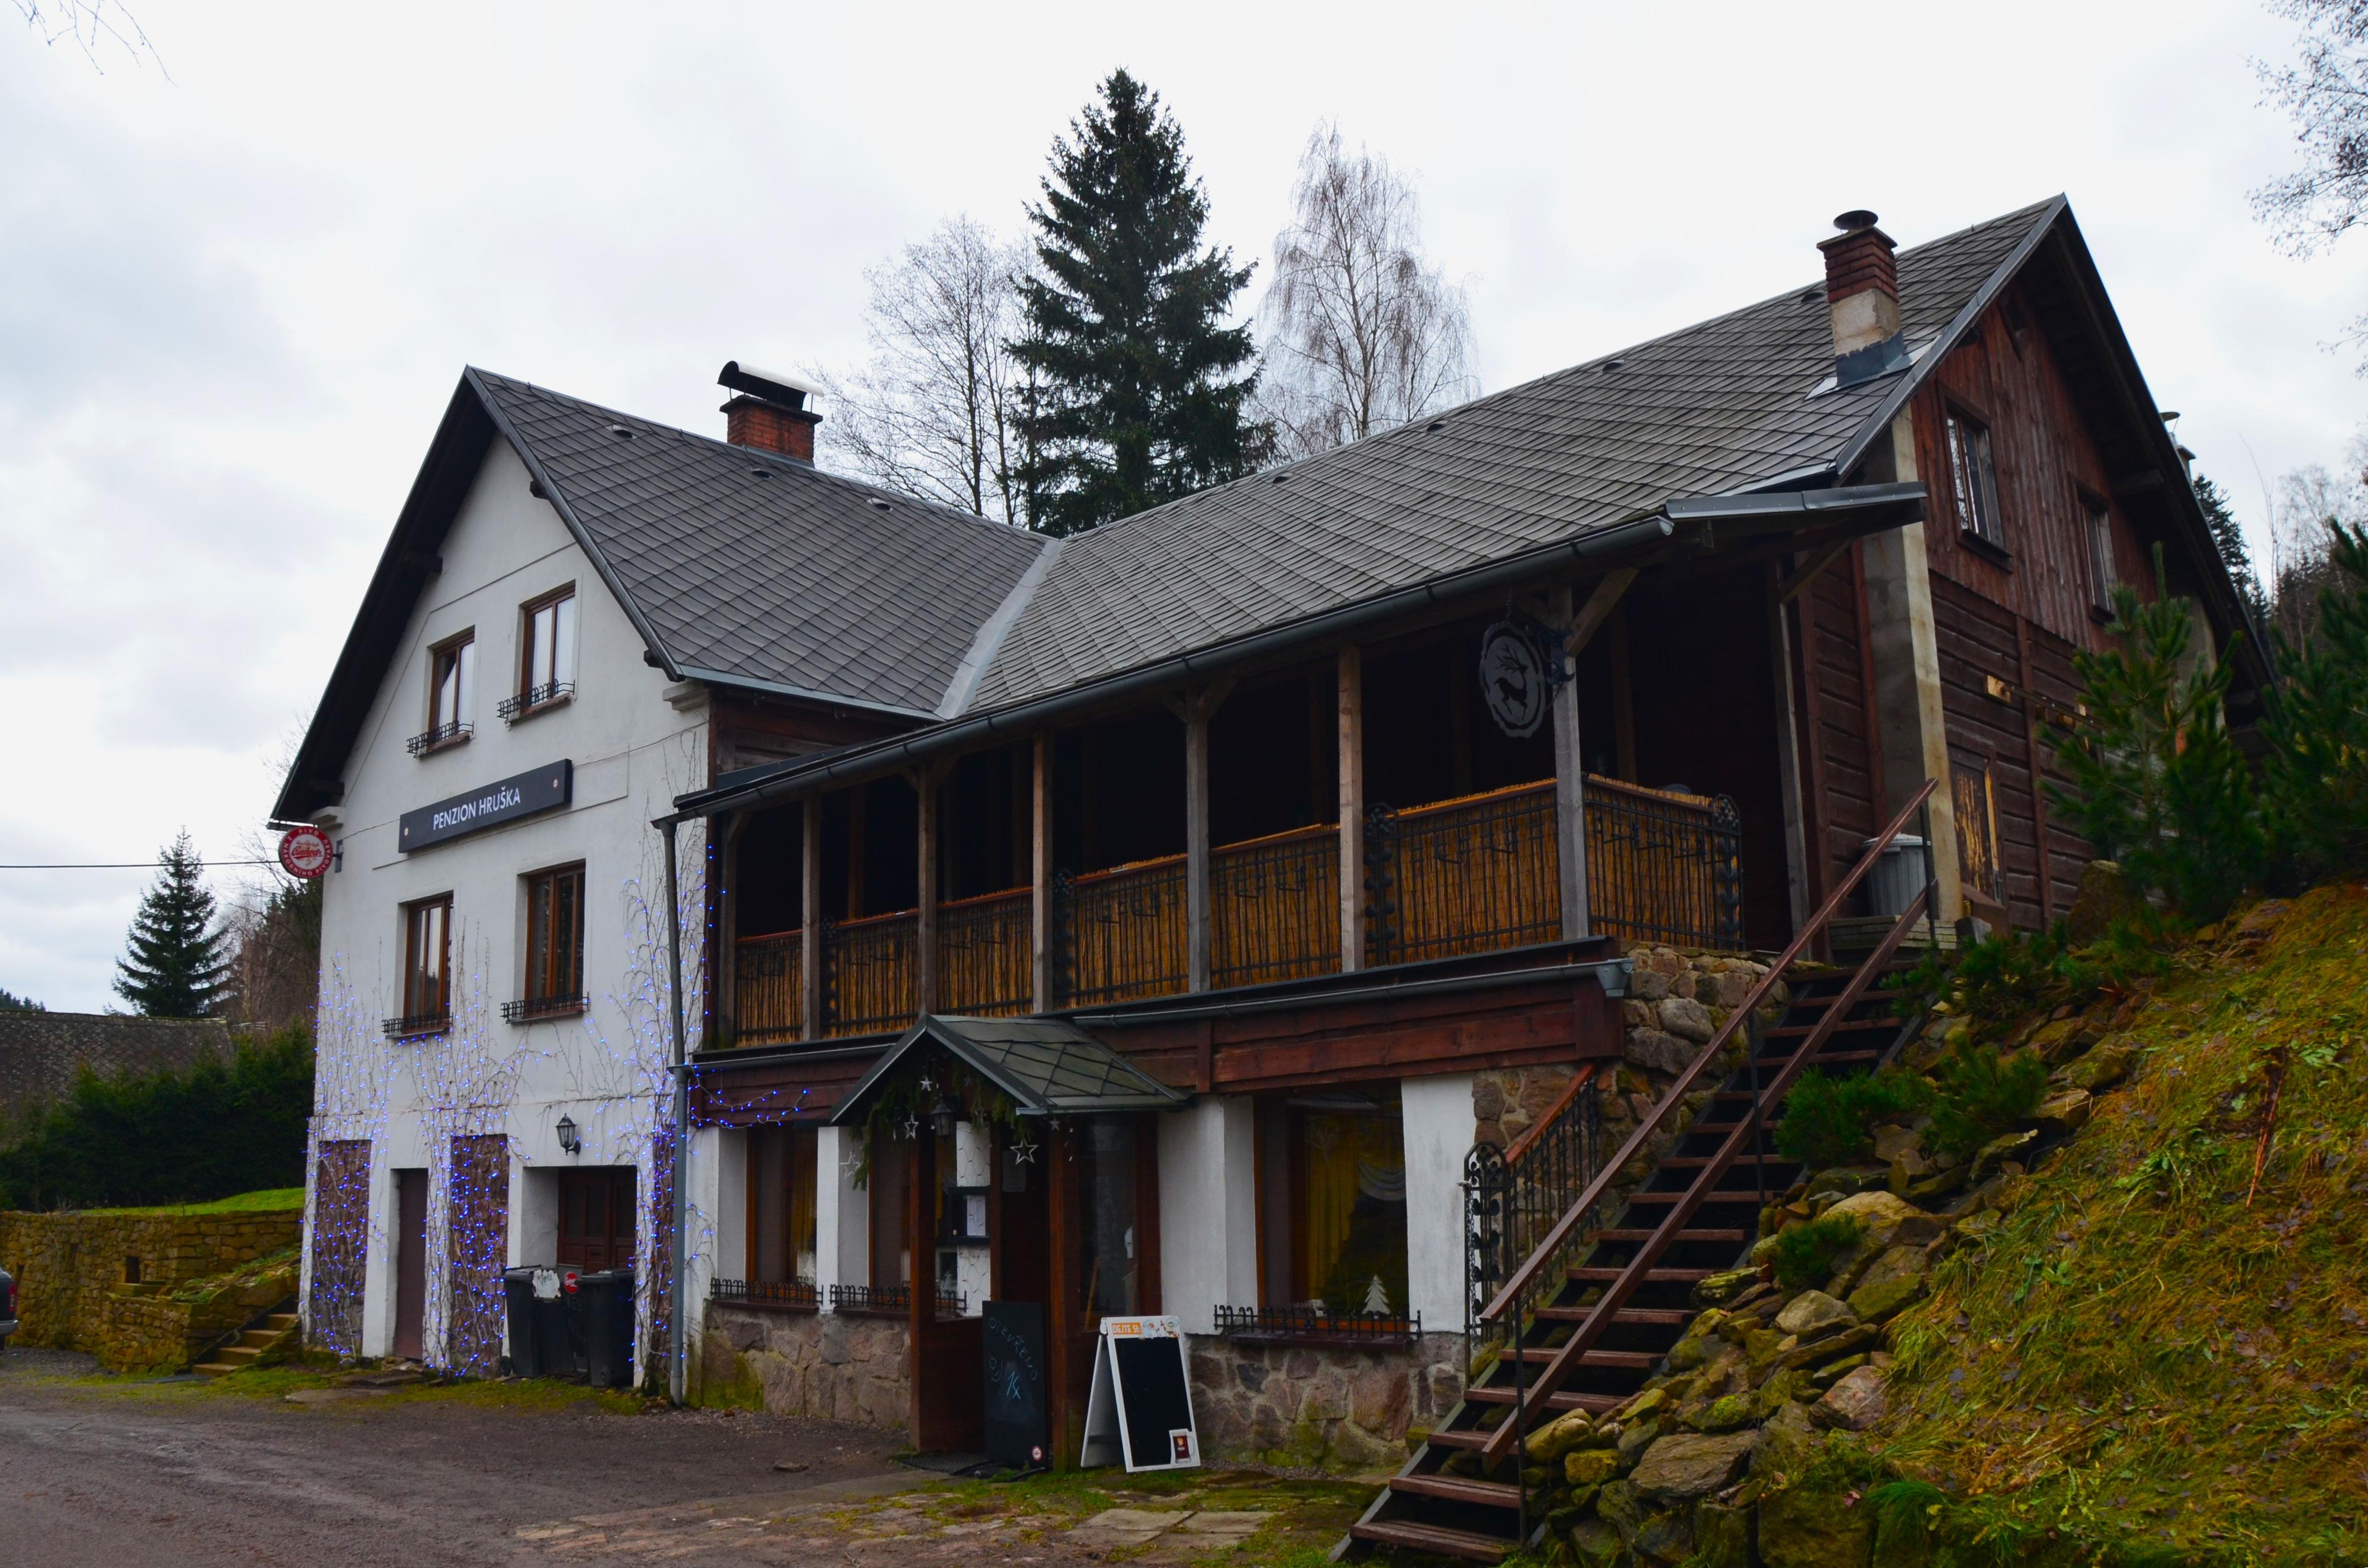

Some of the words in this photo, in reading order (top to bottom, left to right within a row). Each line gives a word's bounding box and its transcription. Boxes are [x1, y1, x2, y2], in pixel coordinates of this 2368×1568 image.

[433, 804, 476, 830] PENZION
[478, 786, 520, 816] HRUŠKA
[1112, 1325, 1131, 1334] DEJTE
